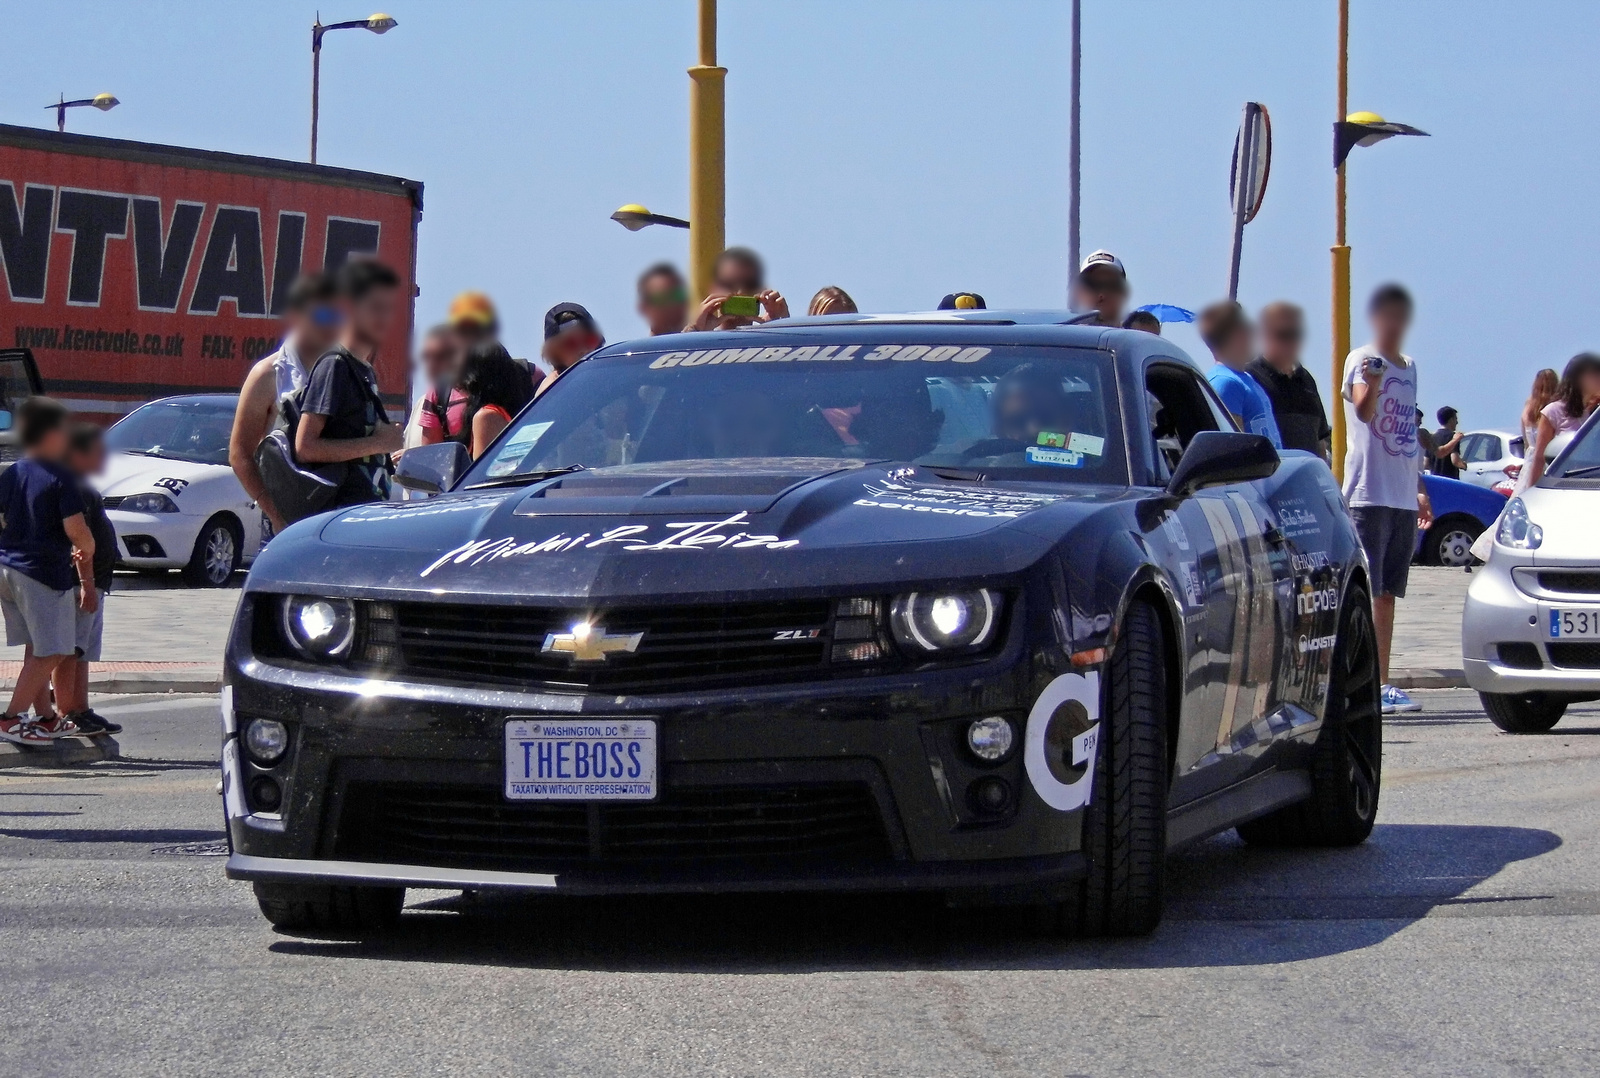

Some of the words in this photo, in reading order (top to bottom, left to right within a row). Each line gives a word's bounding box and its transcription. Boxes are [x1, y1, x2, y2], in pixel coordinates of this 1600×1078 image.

[15, 324, 184, 358] www.kentvale.co.uk
[201, 334, 236, 359] FAX:
[649, 345, 862, 369] GUMBALL
[863, 345, 992, 363] 3000
[1384, 398, 1414, 421] Chup
[420, 531, 591, 578] Miami
[622, 510, 800, 551] Ibiza
[1563, 611, 1598, 634] 531
[773, 629, 820, 640] ZL1
[543, 726, 603, 737] WASHINGTON,
[605, 726, 618, 736] DC
[519, 741, 641, 779] THEBOSS
[512, 784, 548, 795] TAXATION
[550, 784, 583, 795] WITHOUT
[584, 784, 651, 795] REPRESENTATION
